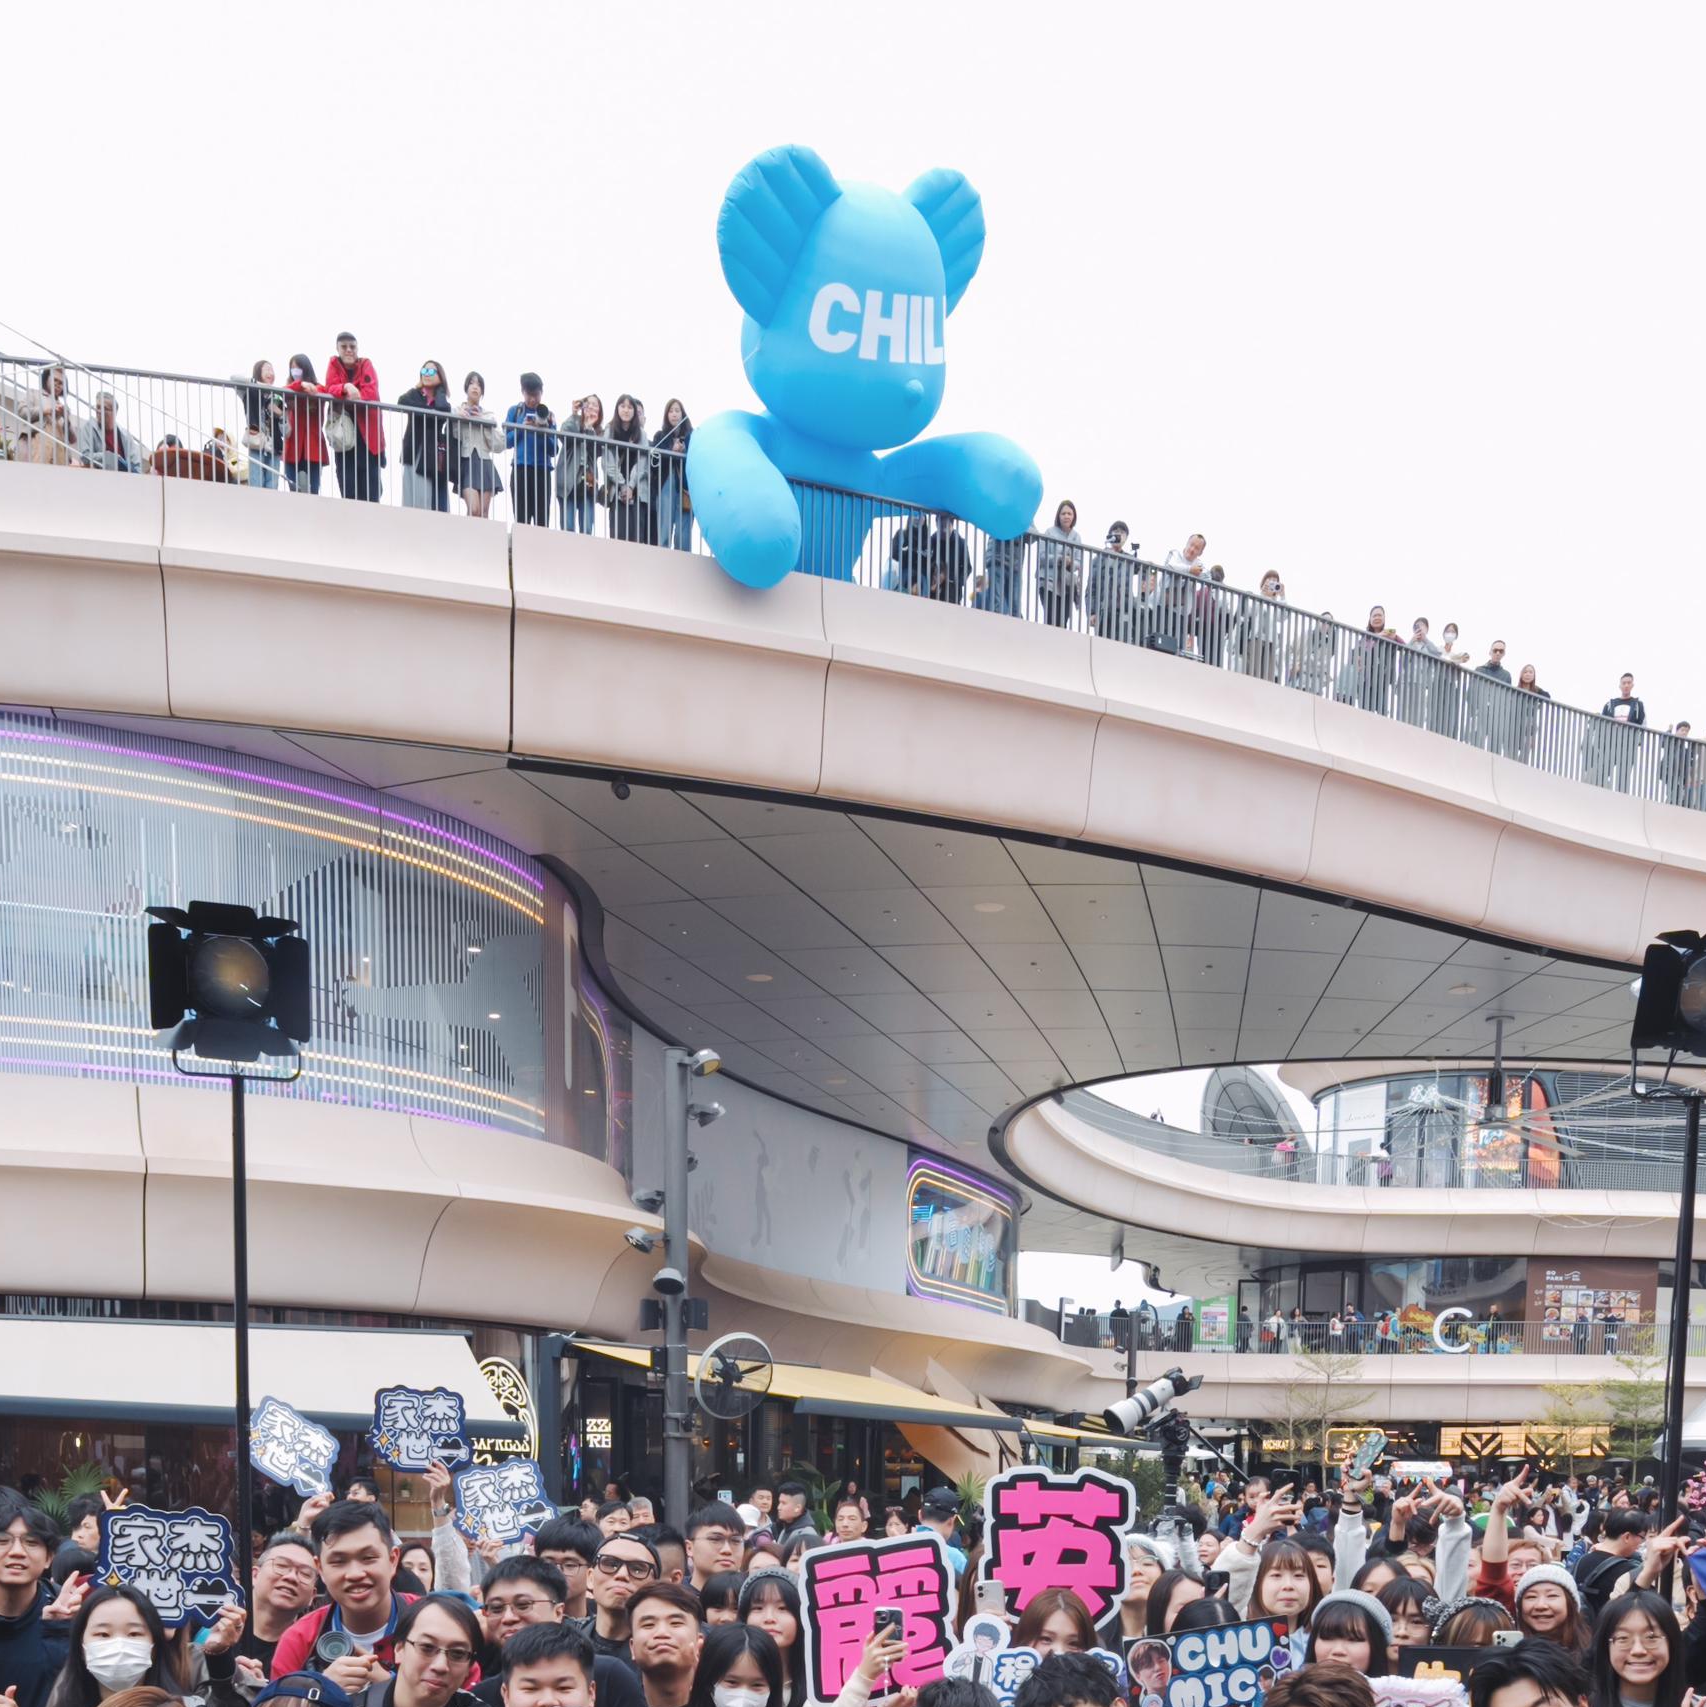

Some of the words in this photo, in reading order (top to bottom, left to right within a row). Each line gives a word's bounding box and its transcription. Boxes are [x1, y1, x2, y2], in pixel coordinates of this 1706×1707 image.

[808, 282, 946, 365] CHIL
[1433, 1307, 1473, 1353] C
[993, 1480, 1124, 1621] 英
[814, 1547, 948, 1701] 麗
[1177, 1624, 1272, 1671] CHU
